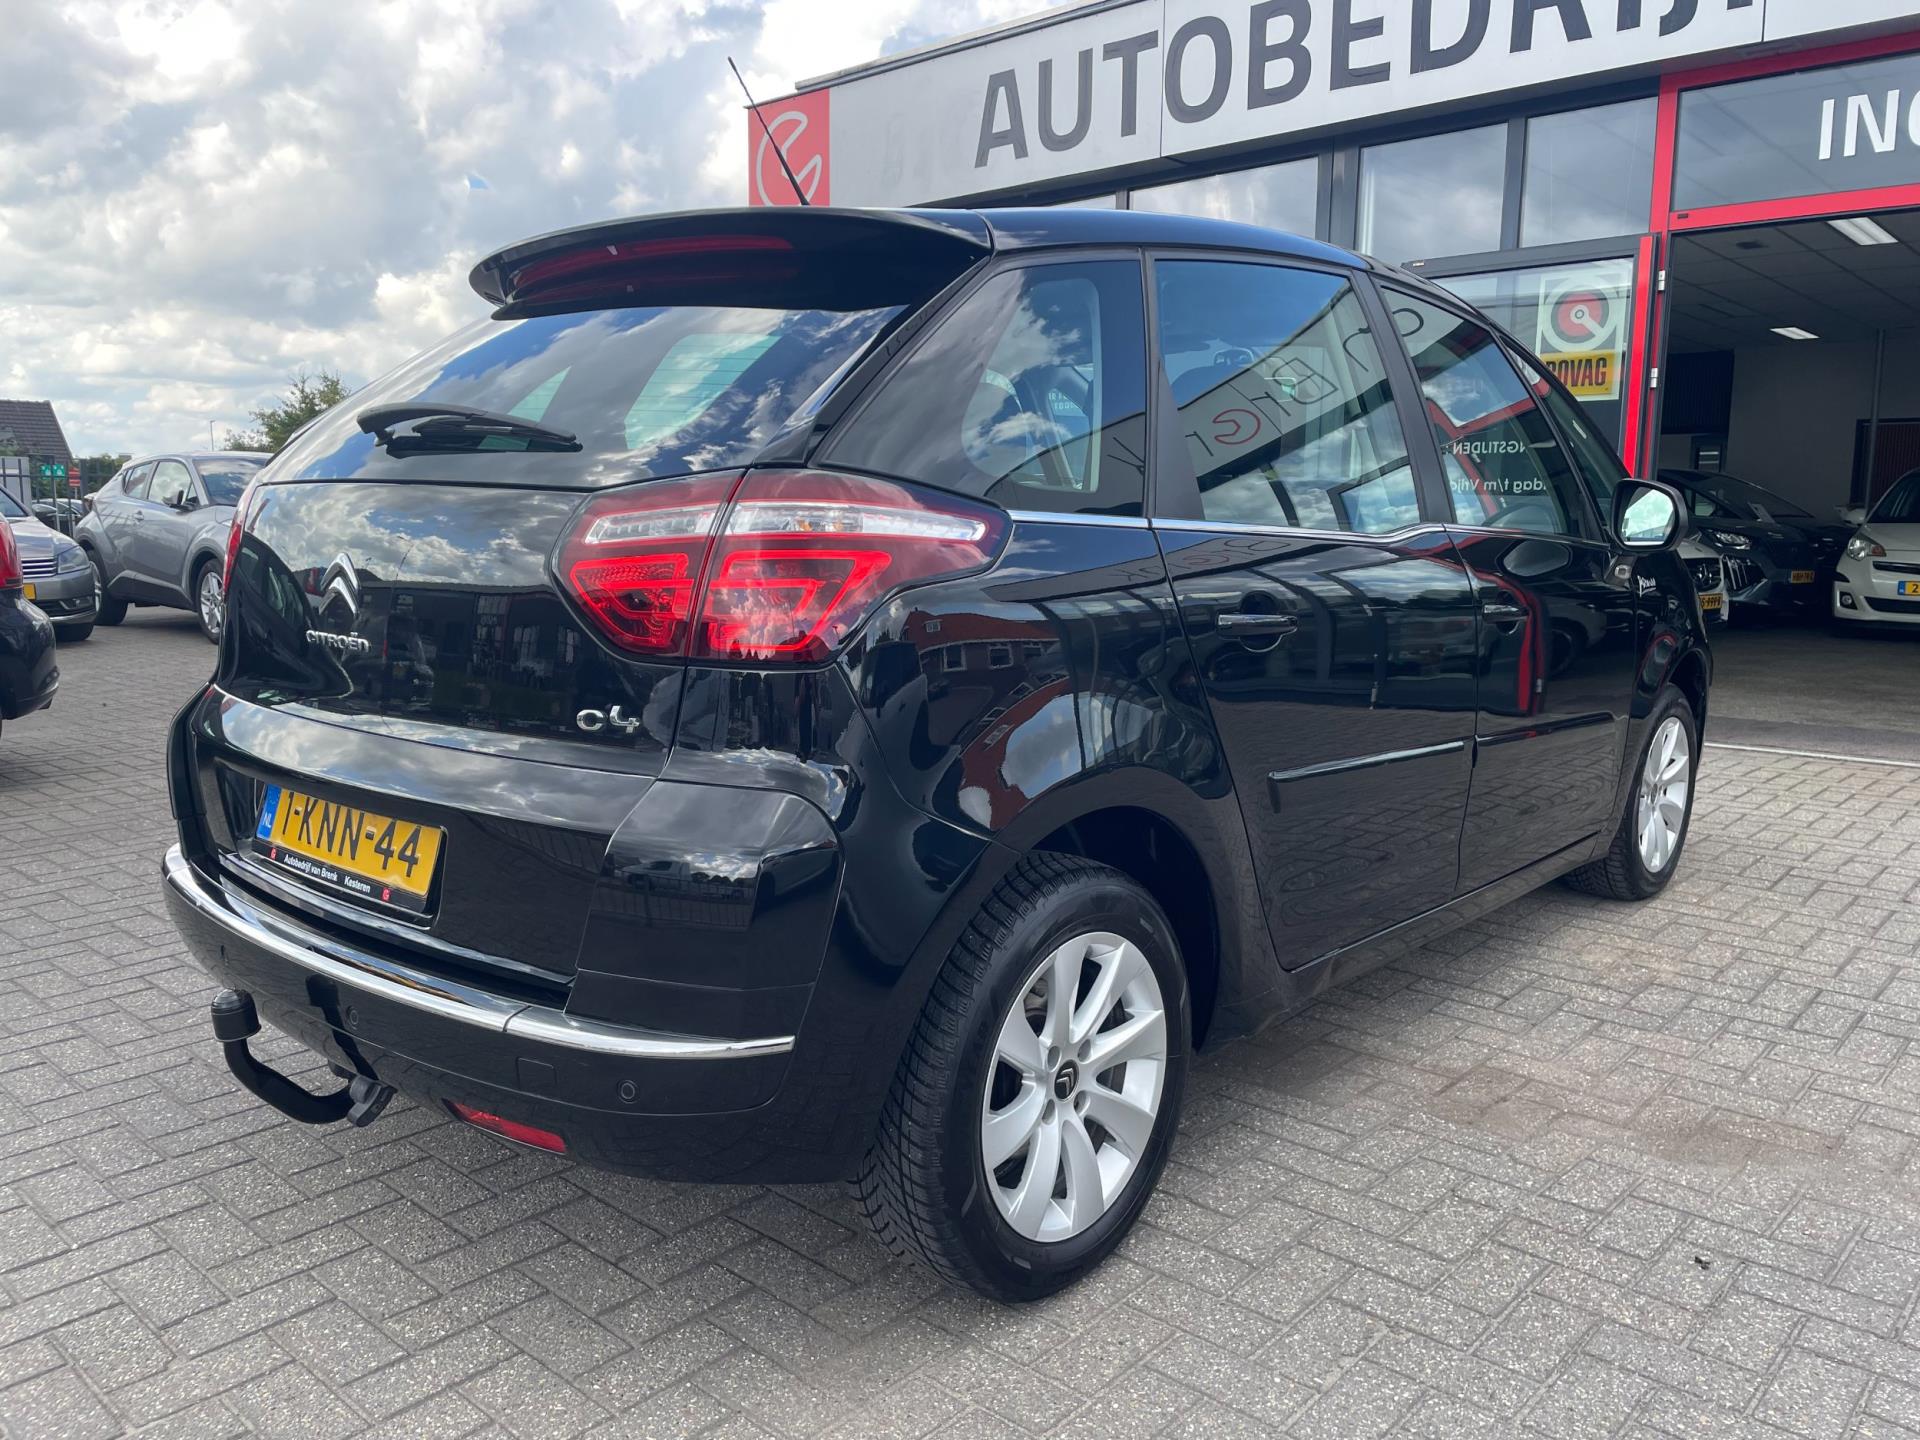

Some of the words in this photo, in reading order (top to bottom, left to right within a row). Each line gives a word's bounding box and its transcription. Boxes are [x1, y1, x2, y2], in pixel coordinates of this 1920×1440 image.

[1818, 85, 1920, 161] IN
[576, 705, 640, 734] C4
[282, 791, 422, 878] 1-KNN-44
